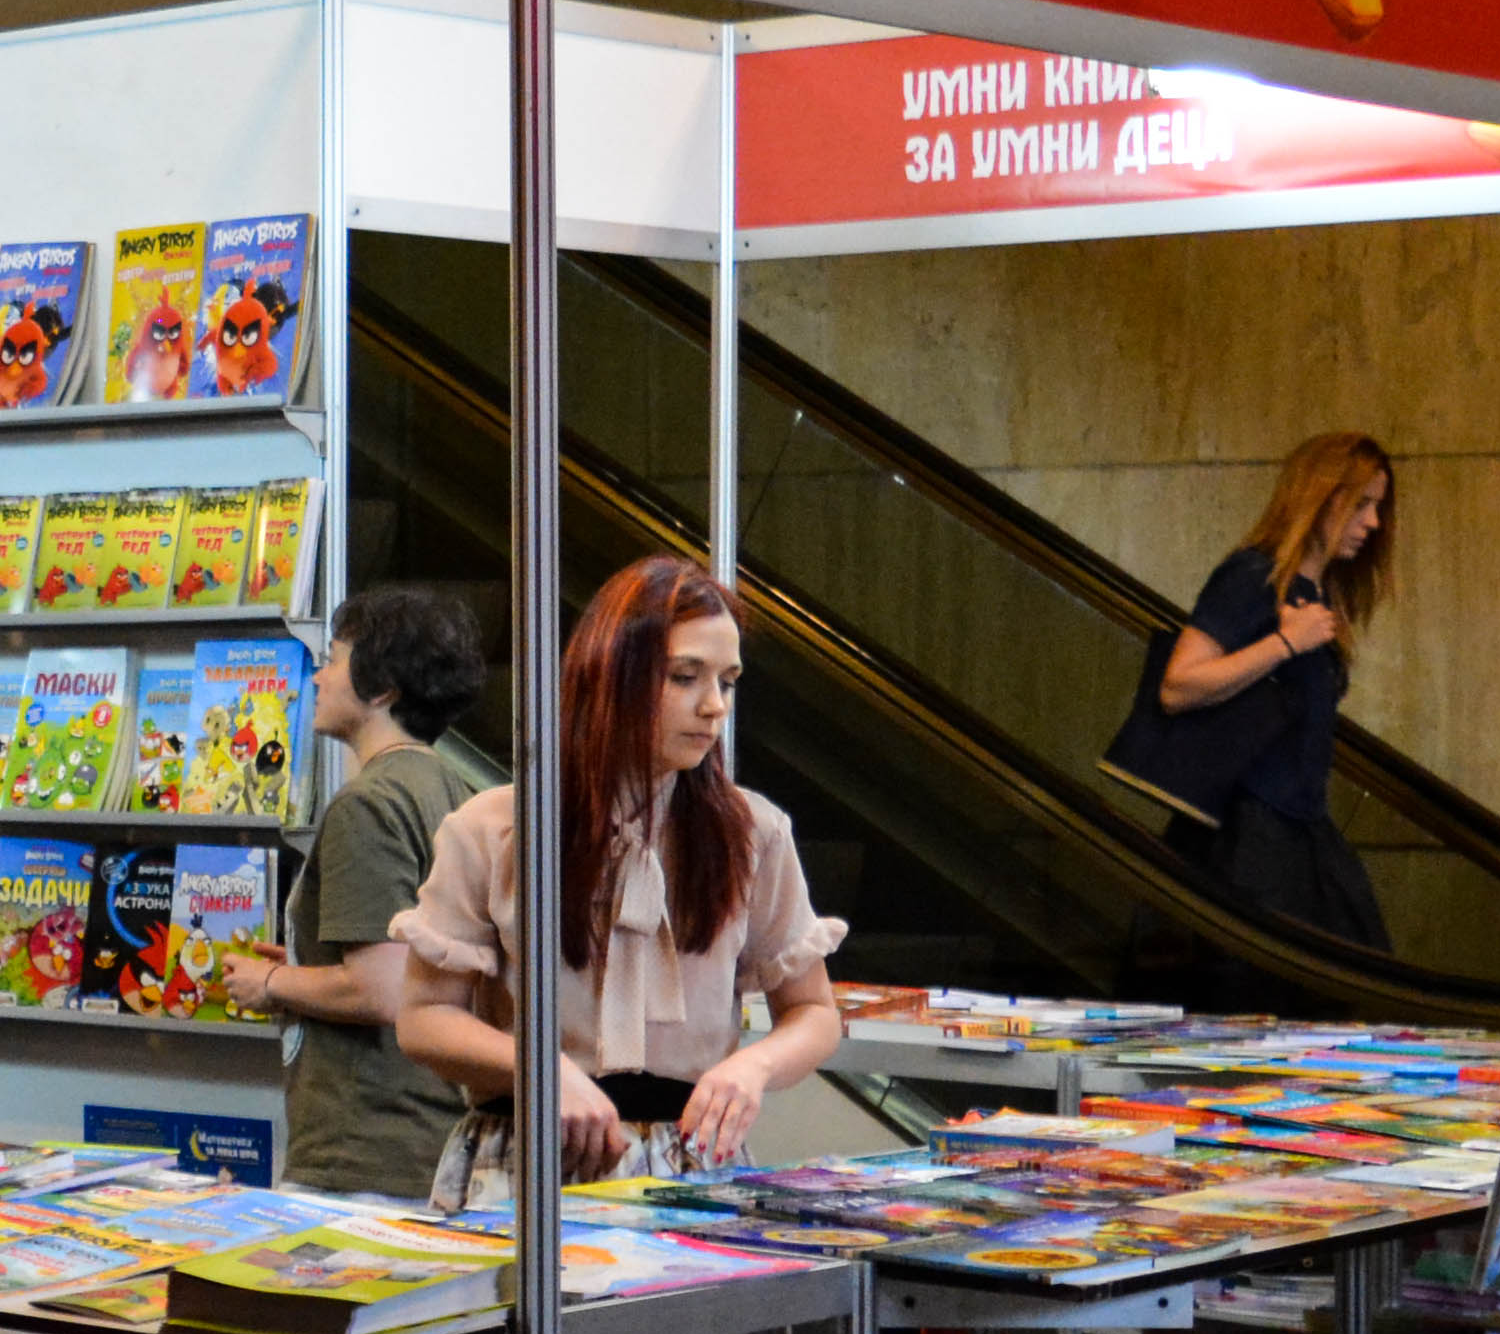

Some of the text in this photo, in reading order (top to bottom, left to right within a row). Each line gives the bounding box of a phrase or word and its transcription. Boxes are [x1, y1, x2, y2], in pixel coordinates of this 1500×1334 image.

[902, 55, 1148, 120] УМНИ КНИ
[904, 132, 956, 183] ЗА
[972, 120, 1098, 178] УМНИ
[213, 227, 255, 252] ANGRY
[256, 221, 299, 245] BIRDS
[39, 245, 77, 269] BIRDS
[34, 672, 117, 696] МАСКИ
[178, 872, 258, 896] ANGRY BIRDS
[114, 896, 172, 910] АСТРОНА
[189, 895, 252, 914] СТИКЕРИ
